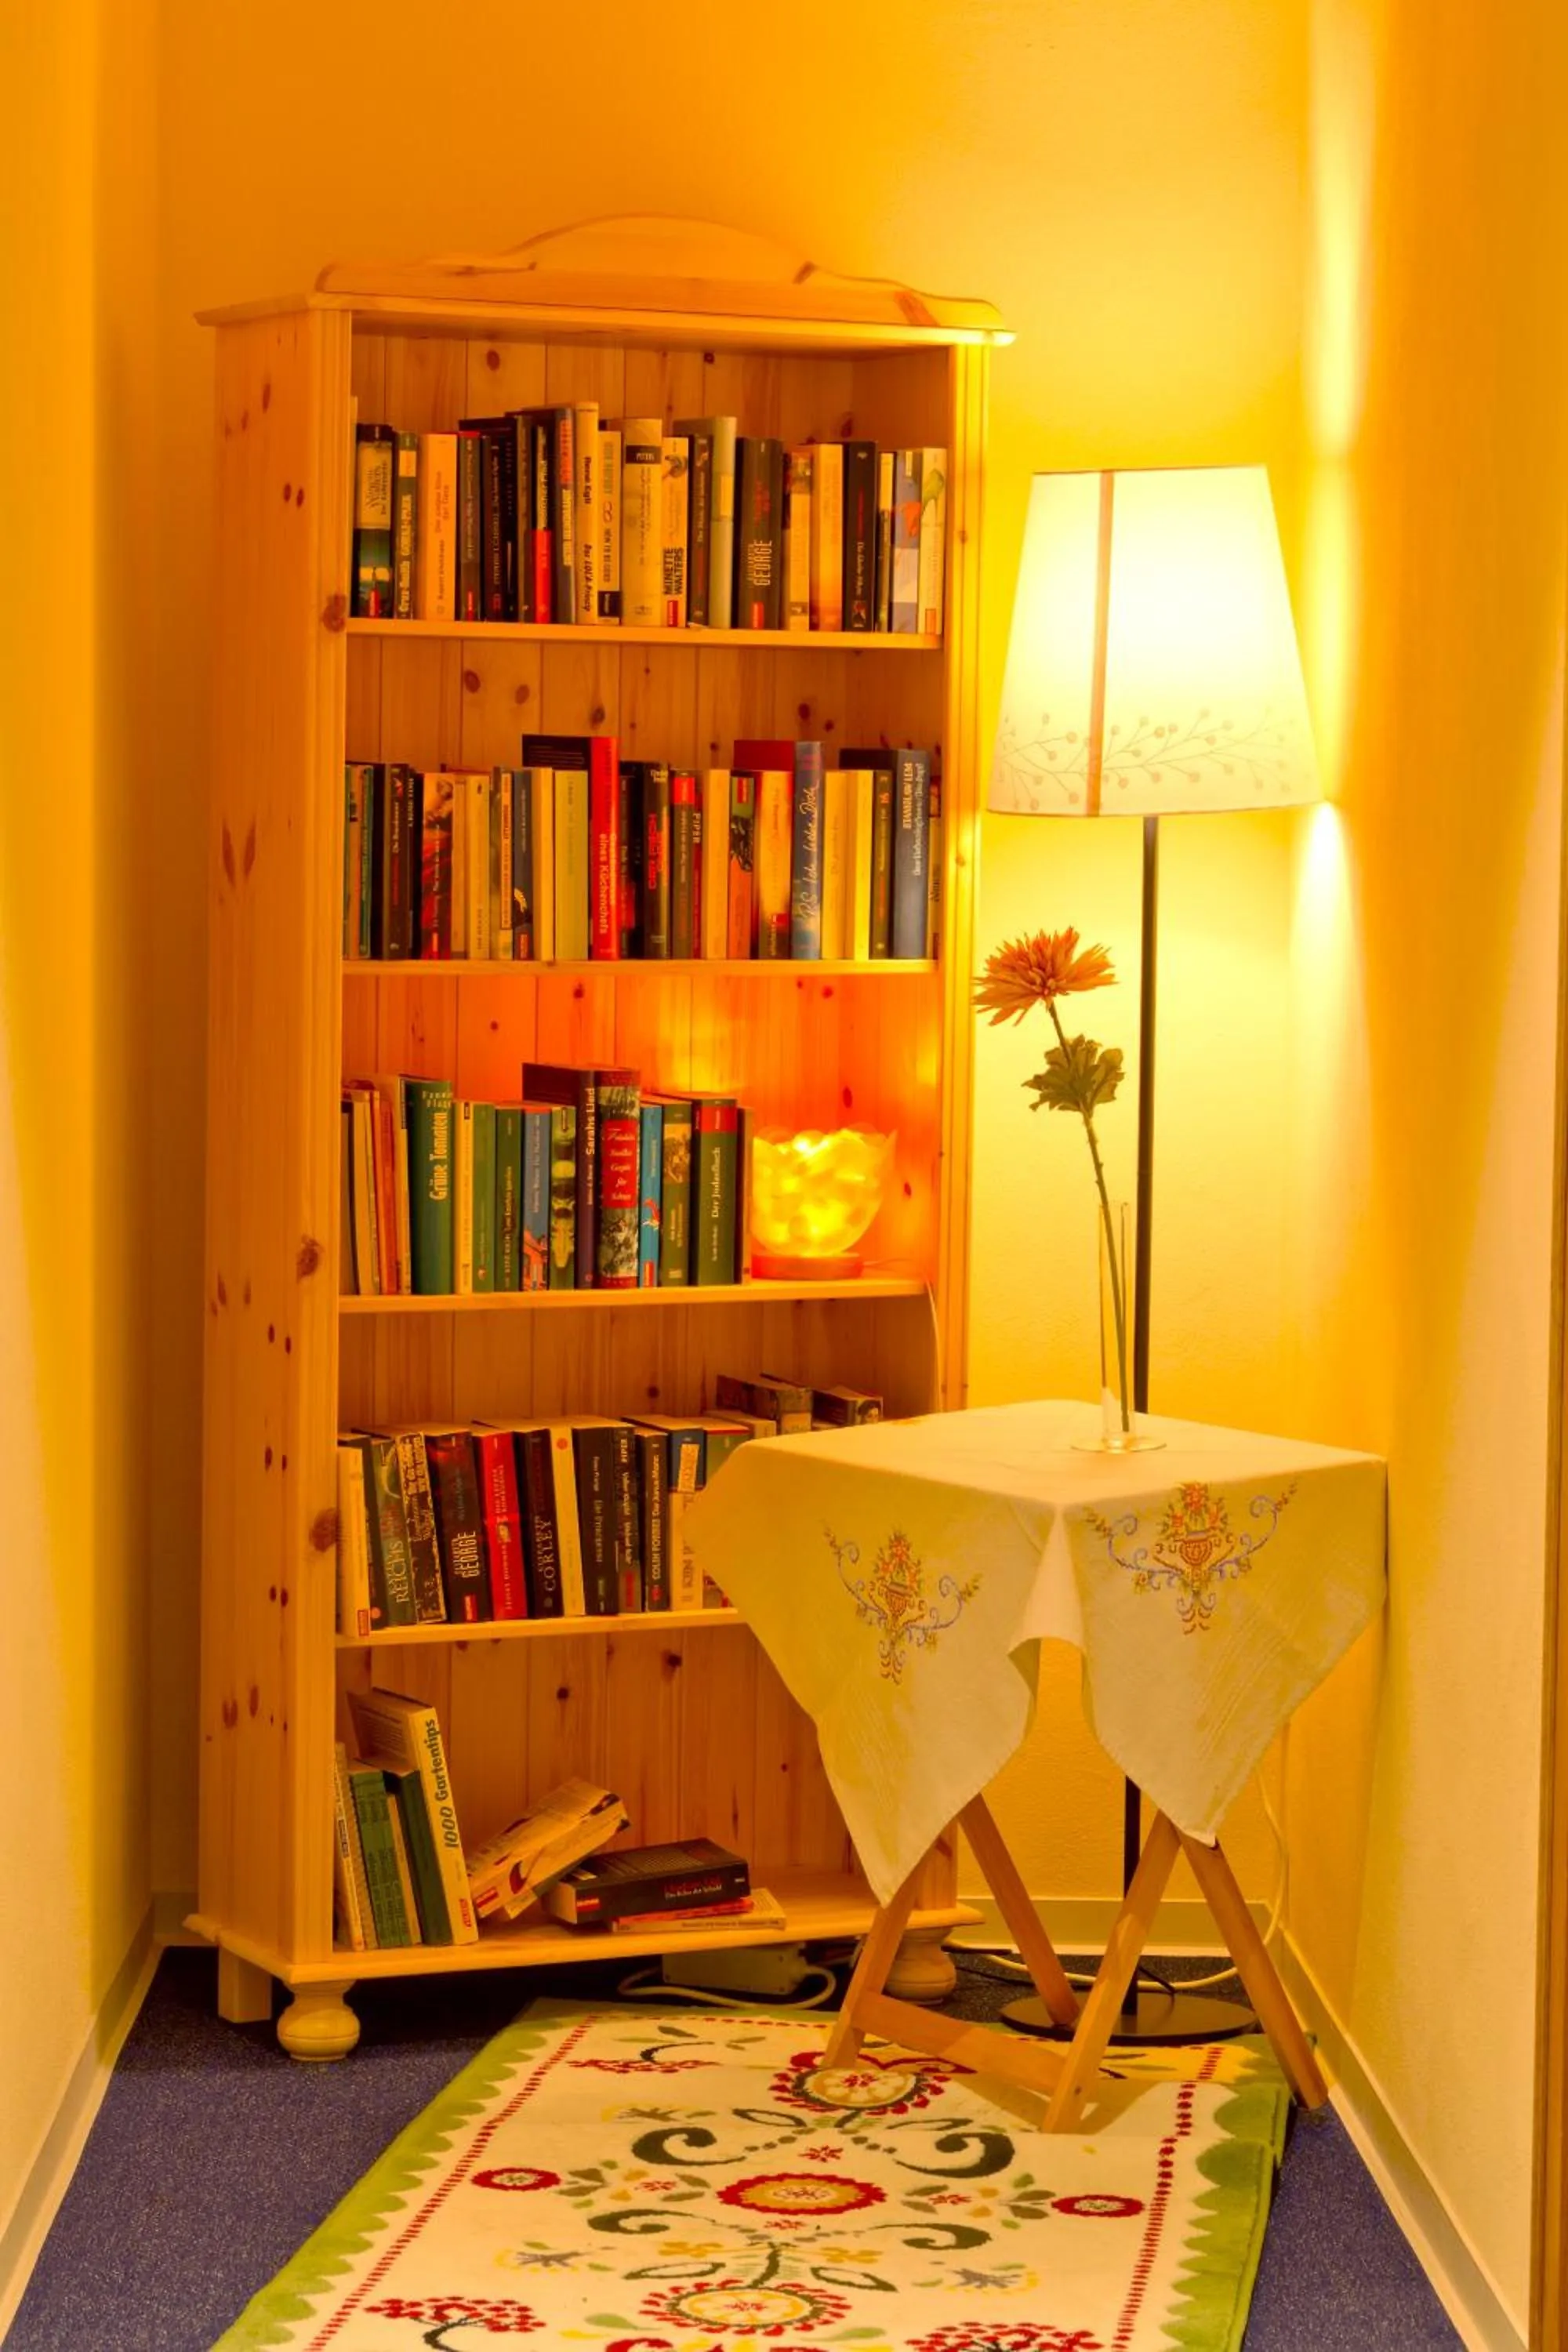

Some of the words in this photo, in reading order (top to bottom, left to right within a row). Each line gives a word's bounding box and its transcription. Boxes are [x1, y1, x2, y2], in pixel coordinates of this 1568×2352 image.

[662, 547, 673, 595] MINETTE
[673, 547, 684, 595] WALTERS
[753, 539, 772, 586] GEORGE
[903, 762, 913, 782] LEM
[598, 831, 608, 862] eines
[692, 812, 701, 844] PIPER
[802, 862, 817, 884] Ich
[598, 864, 609, 935] Küchenchefs
[585, 1087, 595, 1113] Lied
[429, 1112, 448, 1161] Tomaten
[585, 1116, 595, 1156] Sarahs
[429, 1164, 448, 1200] Grüne
[711, 1201, 720, 1218] Der
[390, 1540, 409, 1603] REICHS
[456, 1530, 480, 1578] GEORGE
[540, 1518, 557, 1592] CORLEY
[652, 1553, 660, 1580] COLIN
[681, 1559, 694, 1588] KEN
[423, 1719, 452, 1802] Gartentips
[438, 1806, 460, 1849] 1000
